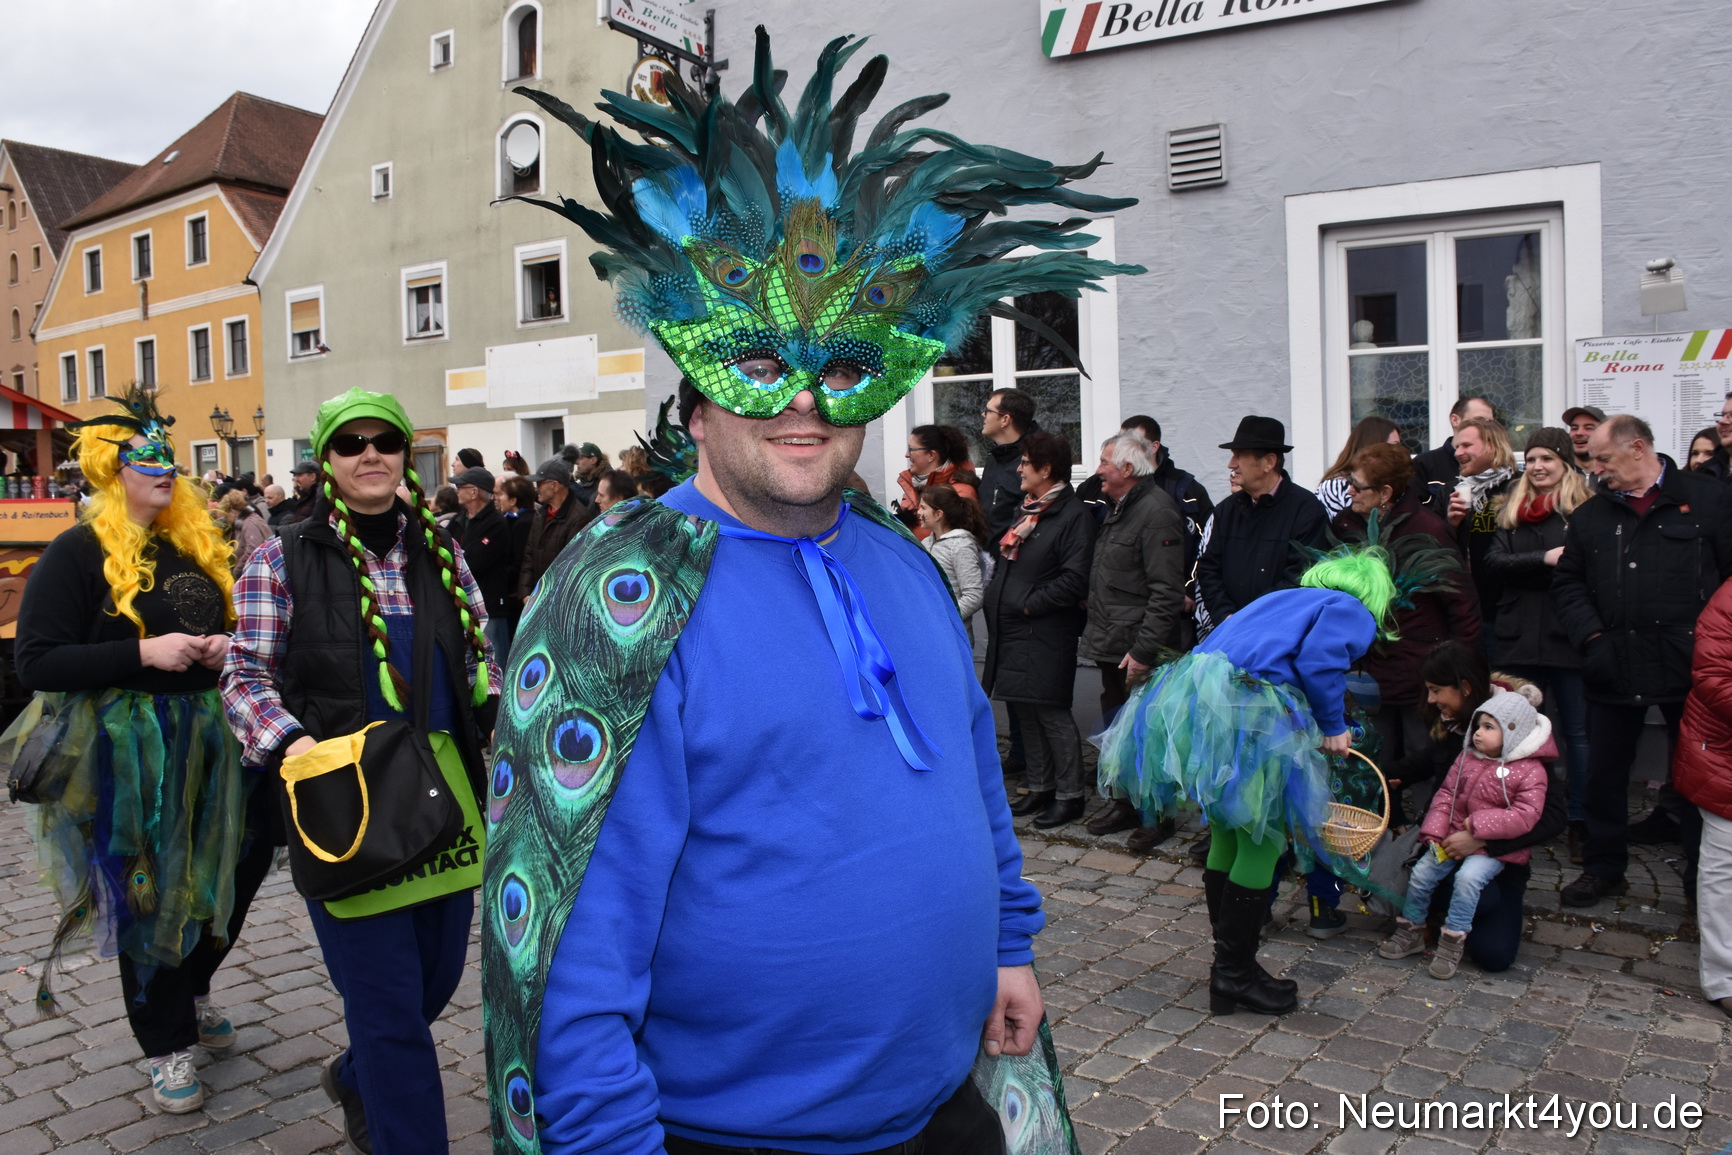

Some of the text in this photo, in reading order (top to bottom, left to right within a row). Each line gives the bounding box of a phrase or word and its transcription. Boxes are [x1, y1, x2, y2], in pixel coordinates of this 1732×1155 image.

[616, 7, 657, 32] Roma
[642, 7, 678, 30] Bella
[1099, 0, 1205, 39] Bella
[1583, 340, 1615, 348] Pizzeria
[1582, 350, 1639, 363] Bella
[1603, 362, 1665, 374] Roma
